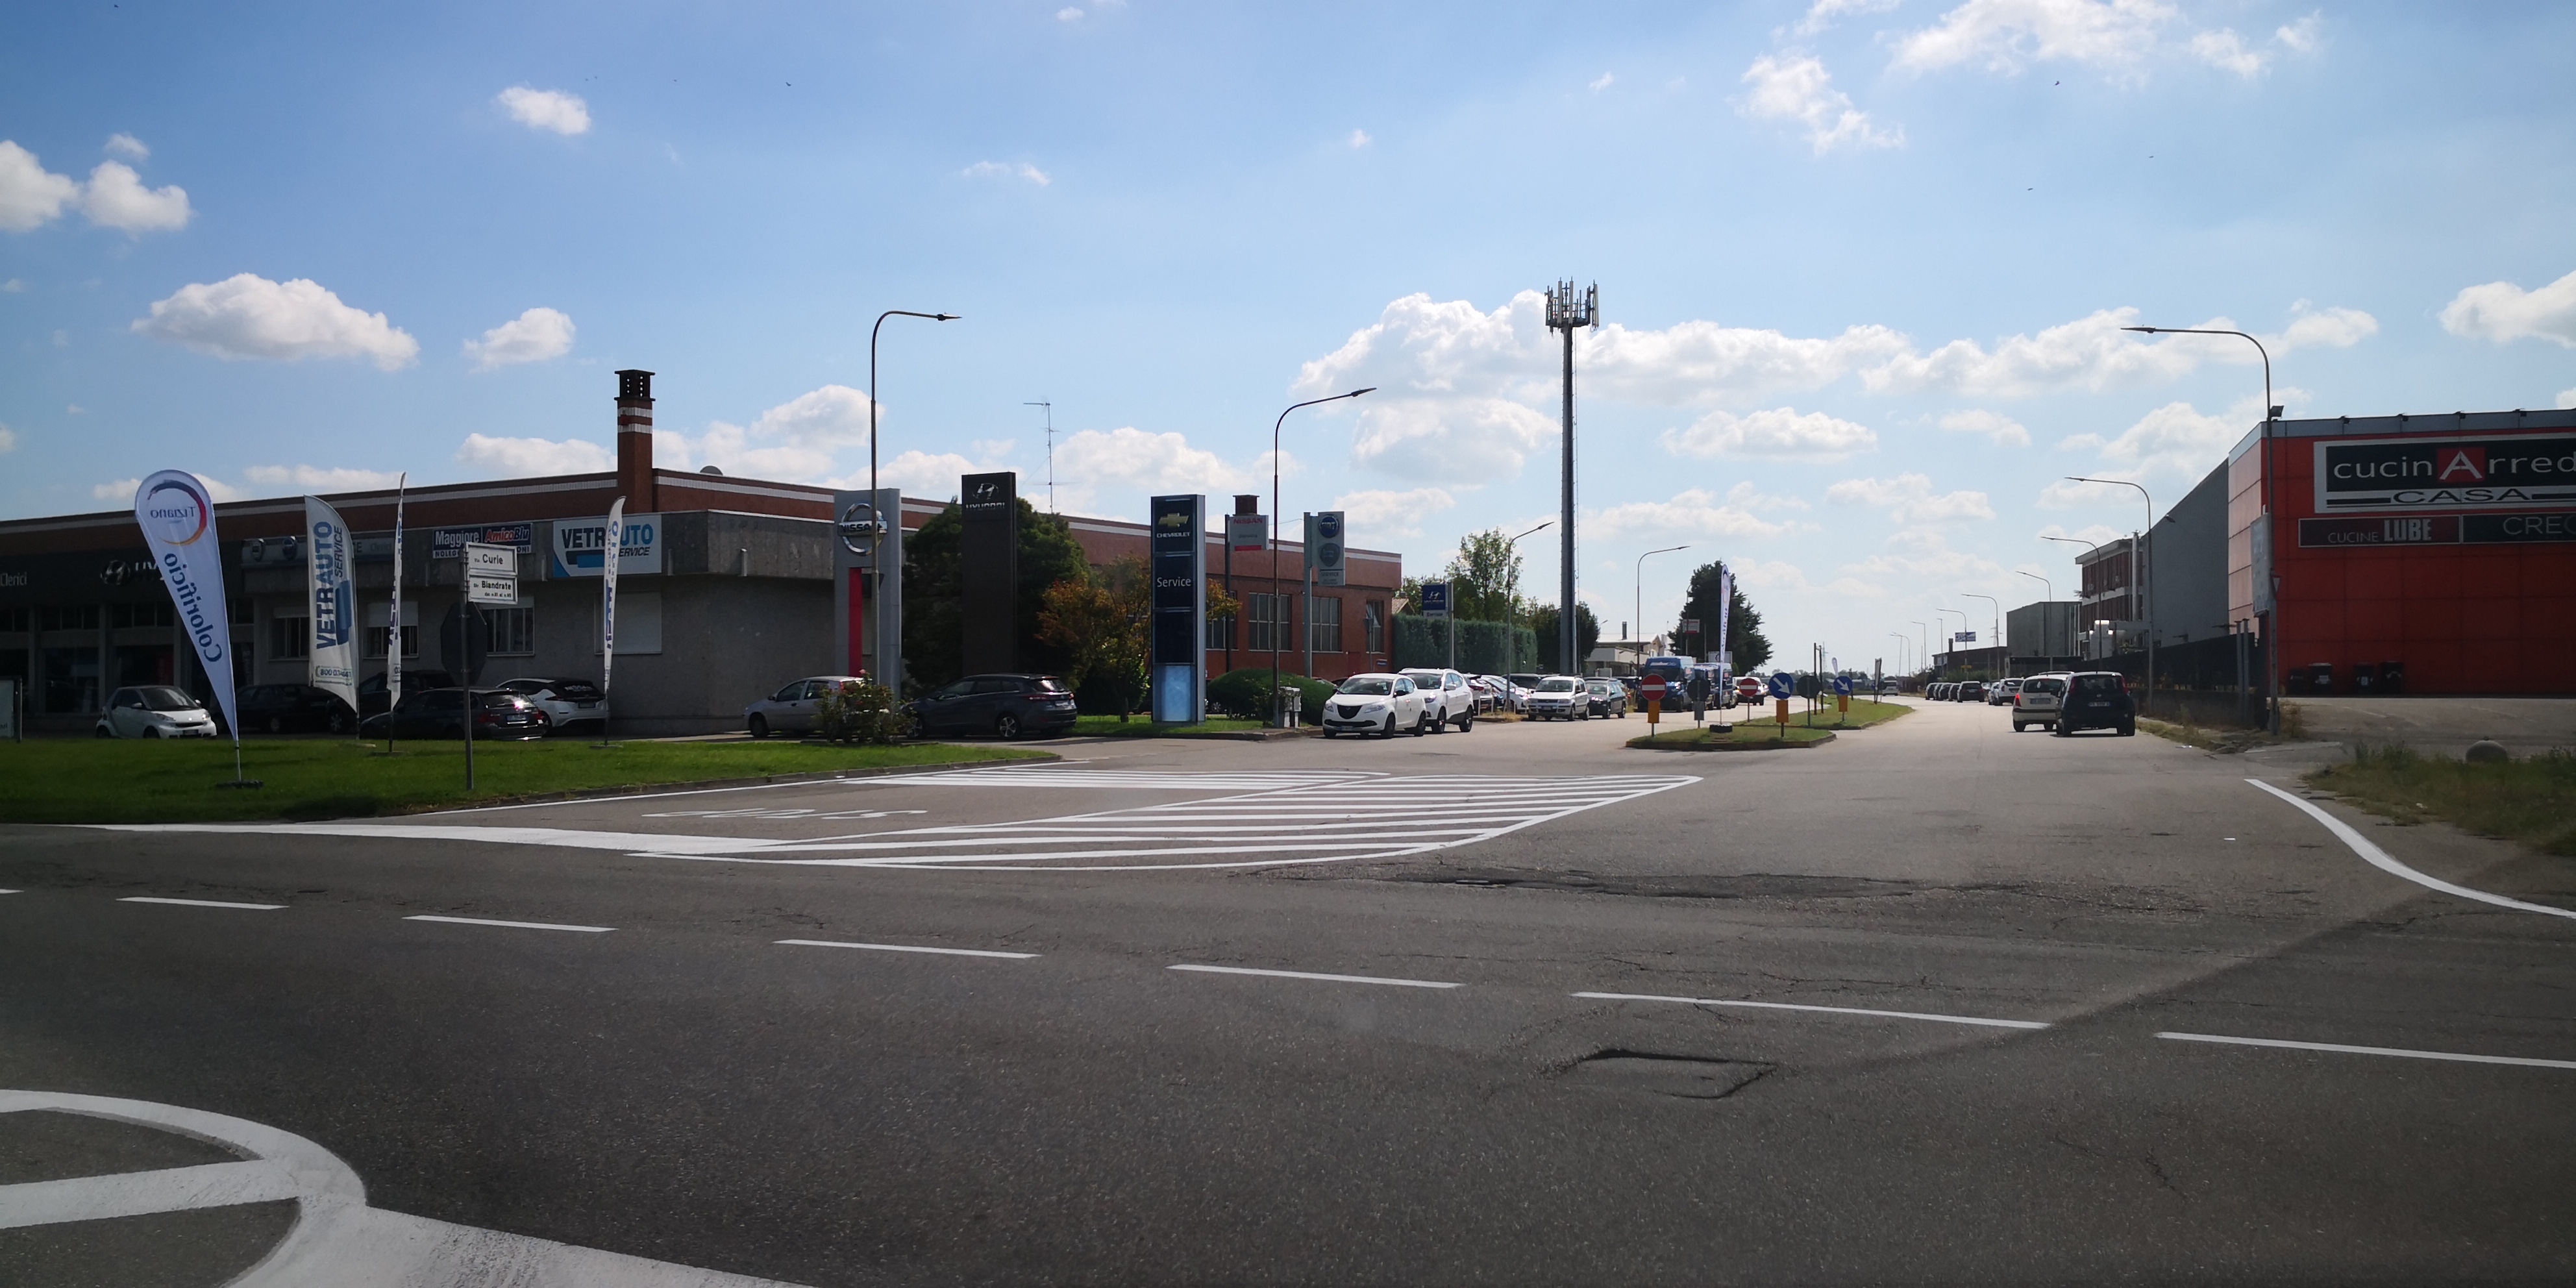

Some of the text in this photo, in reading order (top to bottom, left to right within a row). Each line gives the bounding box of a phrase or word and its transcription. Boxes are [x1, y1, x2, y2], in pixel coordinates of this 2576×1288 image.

[2393, 488, 2530, 503] CASA
[435, 526, 530, 548] Maggiore AmicoBlu
[562, 523, 654, 549] VETRUTO
[2328, 519, 2431, 543] CUCINE LUBE
[334, 525, 343, 578] SERVICE
[482, 554, 503, 564] Curie
[619, 547, 650, 557] ERVICE
[314, 521, 336, 649] VETRAUTO
[482, 580, 512, 590] Biandrate
[1157, 576, 1192, 588] Service
